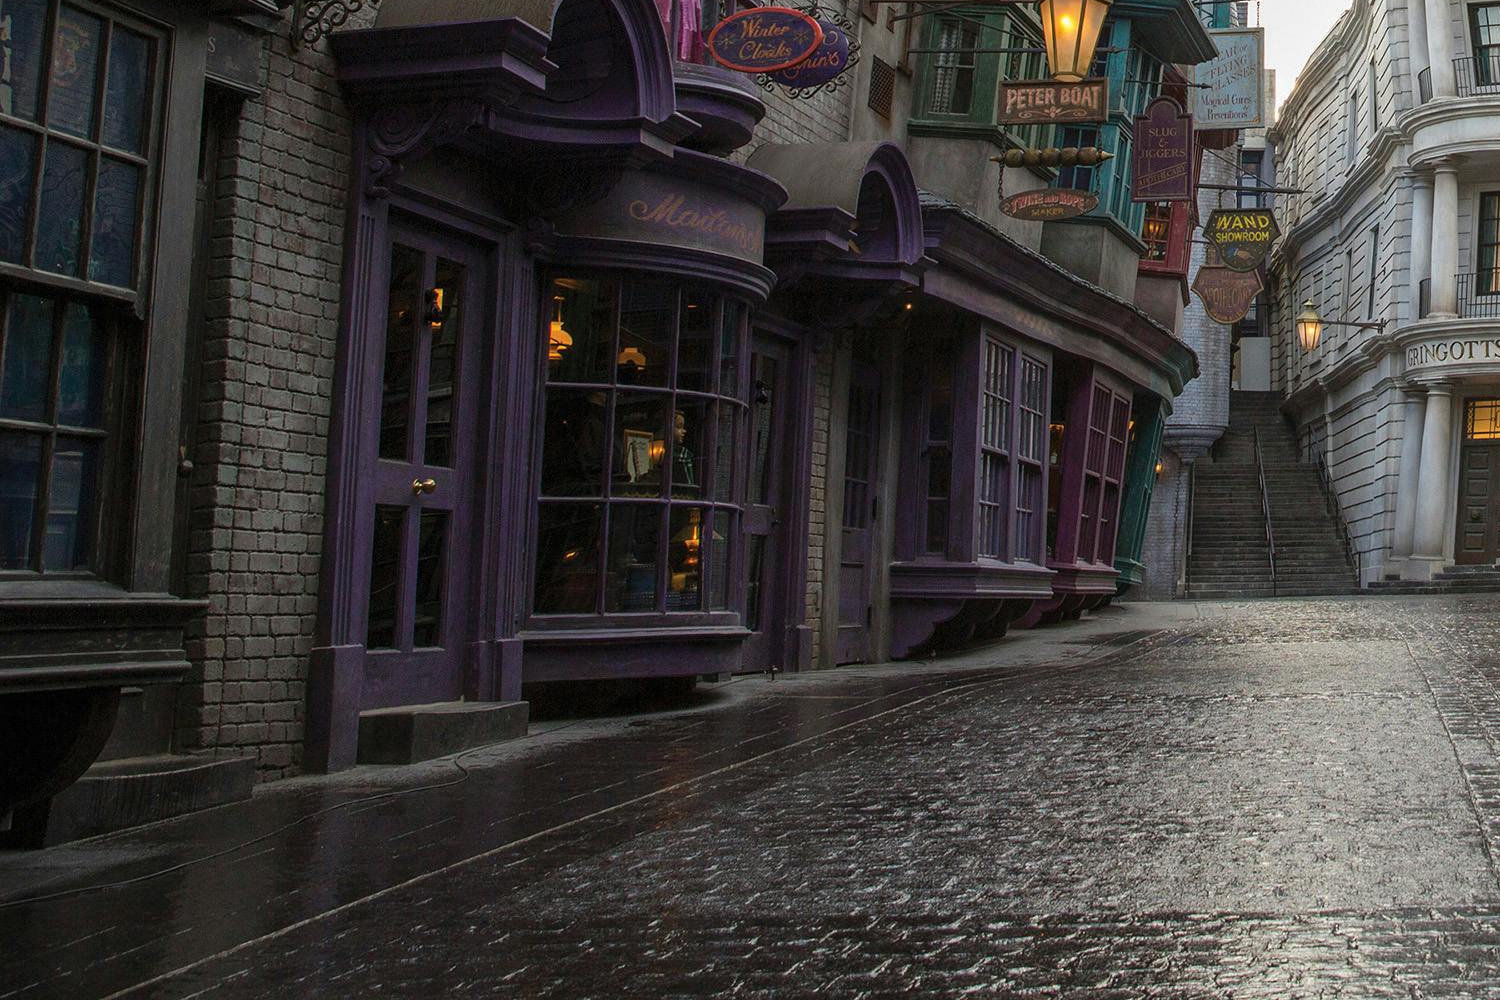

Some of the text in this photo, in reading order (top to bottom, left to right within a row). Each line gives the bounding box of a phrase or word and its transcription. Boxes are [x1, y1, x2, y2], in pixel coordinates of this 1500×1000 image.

[740, 16, 791, 40] Winter
[739, 41, 793, 60] Cloaks
[1210, 55, 1247, 79] FLYING
[1006, 86, 1102, 114] PETER BOAT
[1207, 108, 1248, 121] Preventions
[1148, 127, 1177, 137] SLUG
[1138, 148, 1186, 160] JIGGERS
[1138, 164, 1187, 186] APOTHECARY
[1031, 207, 1065, 217] MAKER
[630, 193, 747, 249] Madam
[1216, 215, 1270, 231] WAND
[1215, 231, 1270, 243] SHOWROOM
